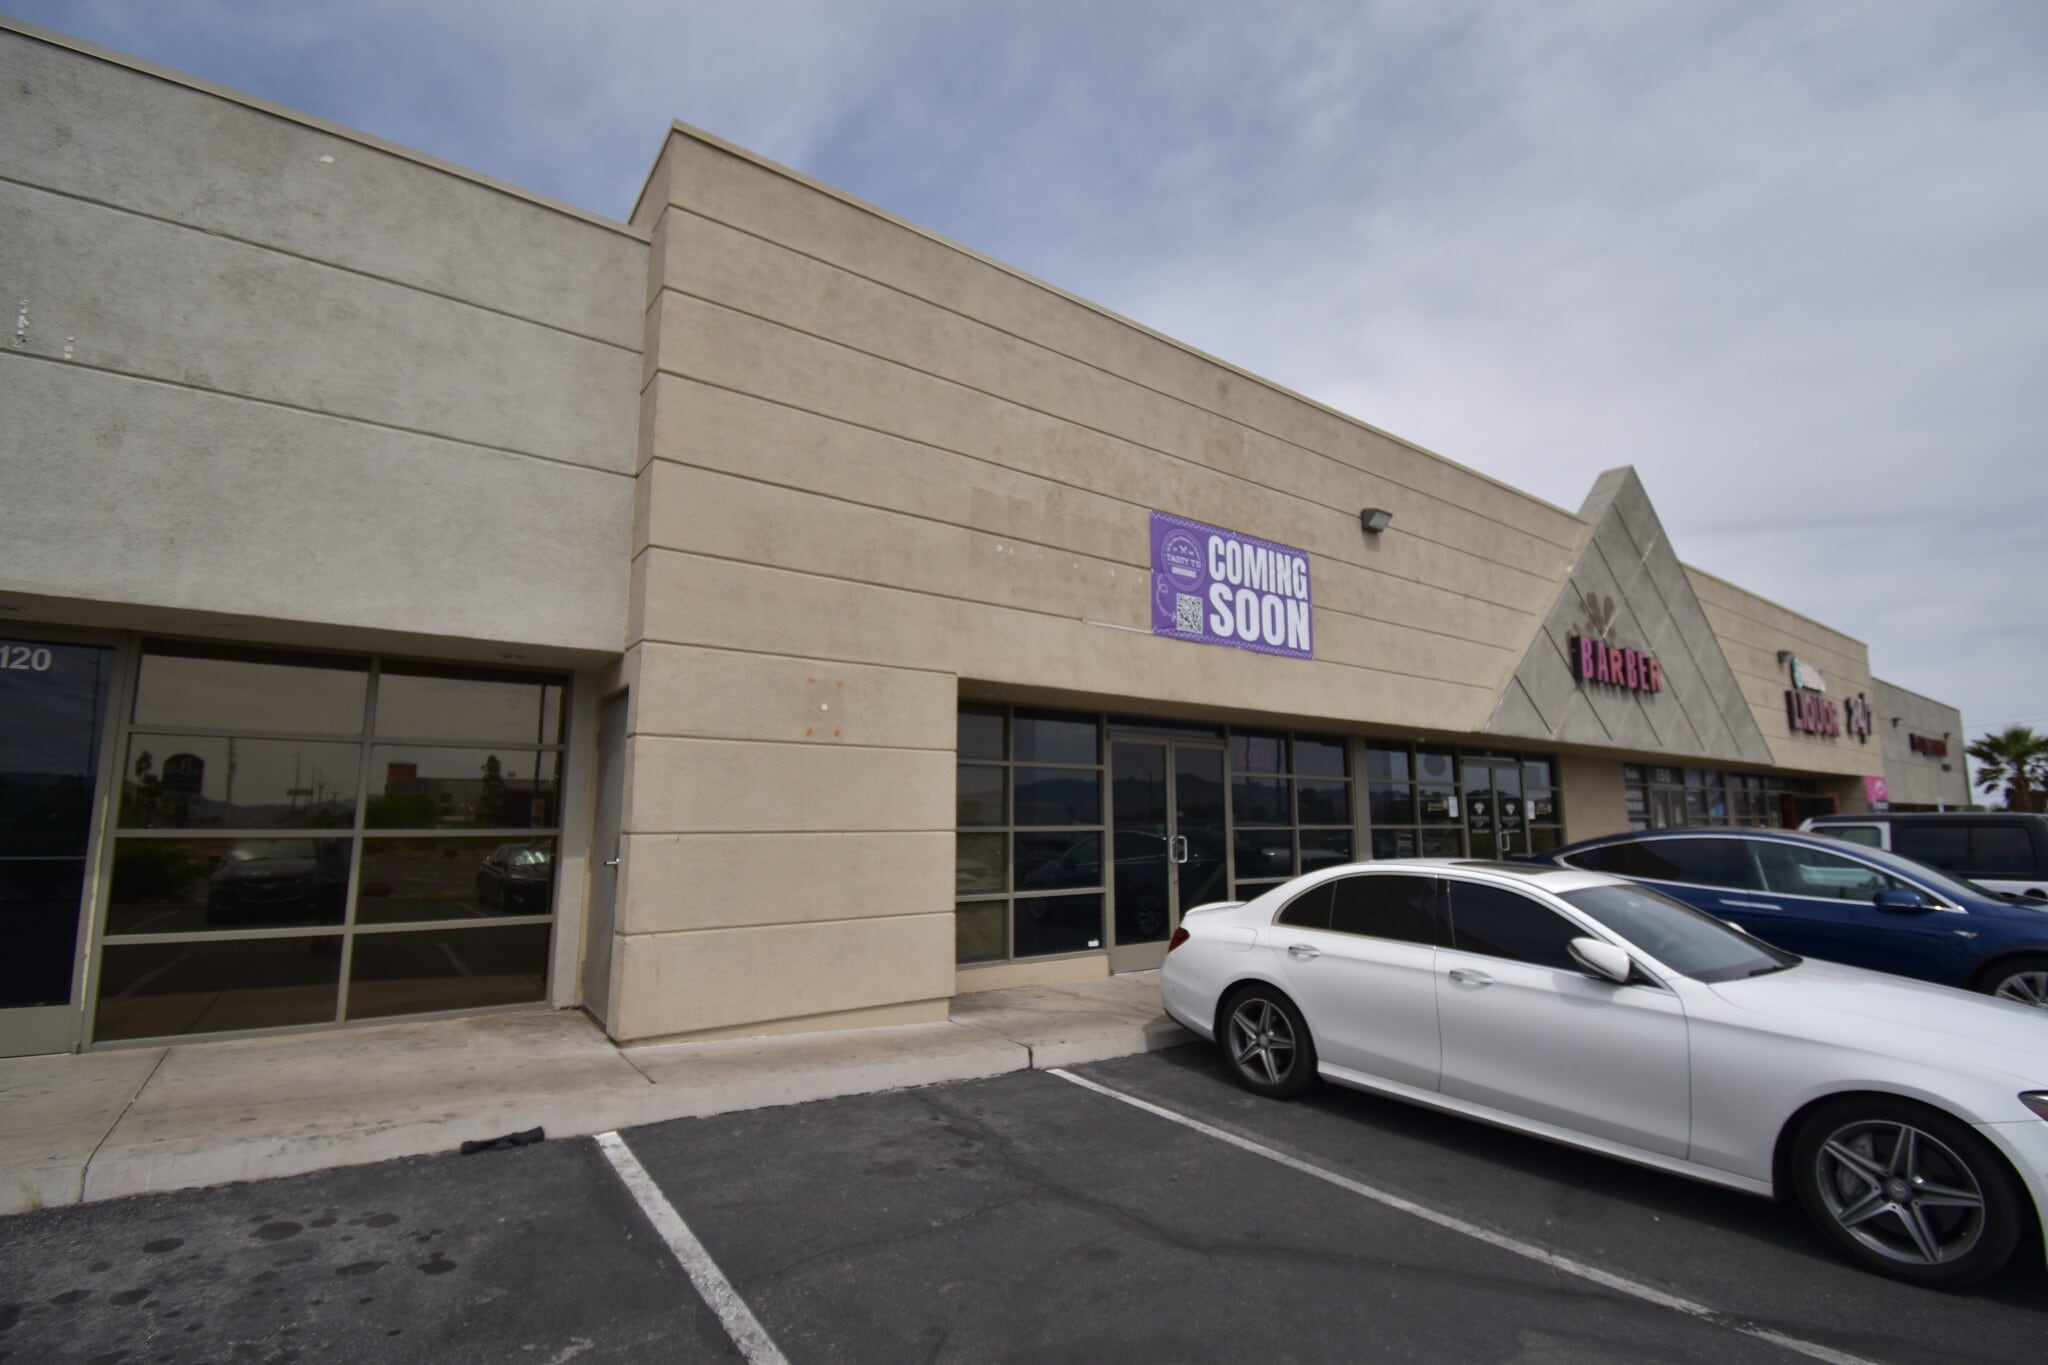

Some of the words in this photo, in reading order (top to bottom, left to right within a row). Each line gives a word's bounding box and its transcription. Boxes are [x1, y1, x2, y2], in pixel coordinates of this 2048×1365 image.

[1208, 535, 1308, 600] COMING
[1209, 582, 1310, 651] SOON
[0, 645, 52, 672] 120
[1574, 635, 1663, 693] BARBER
